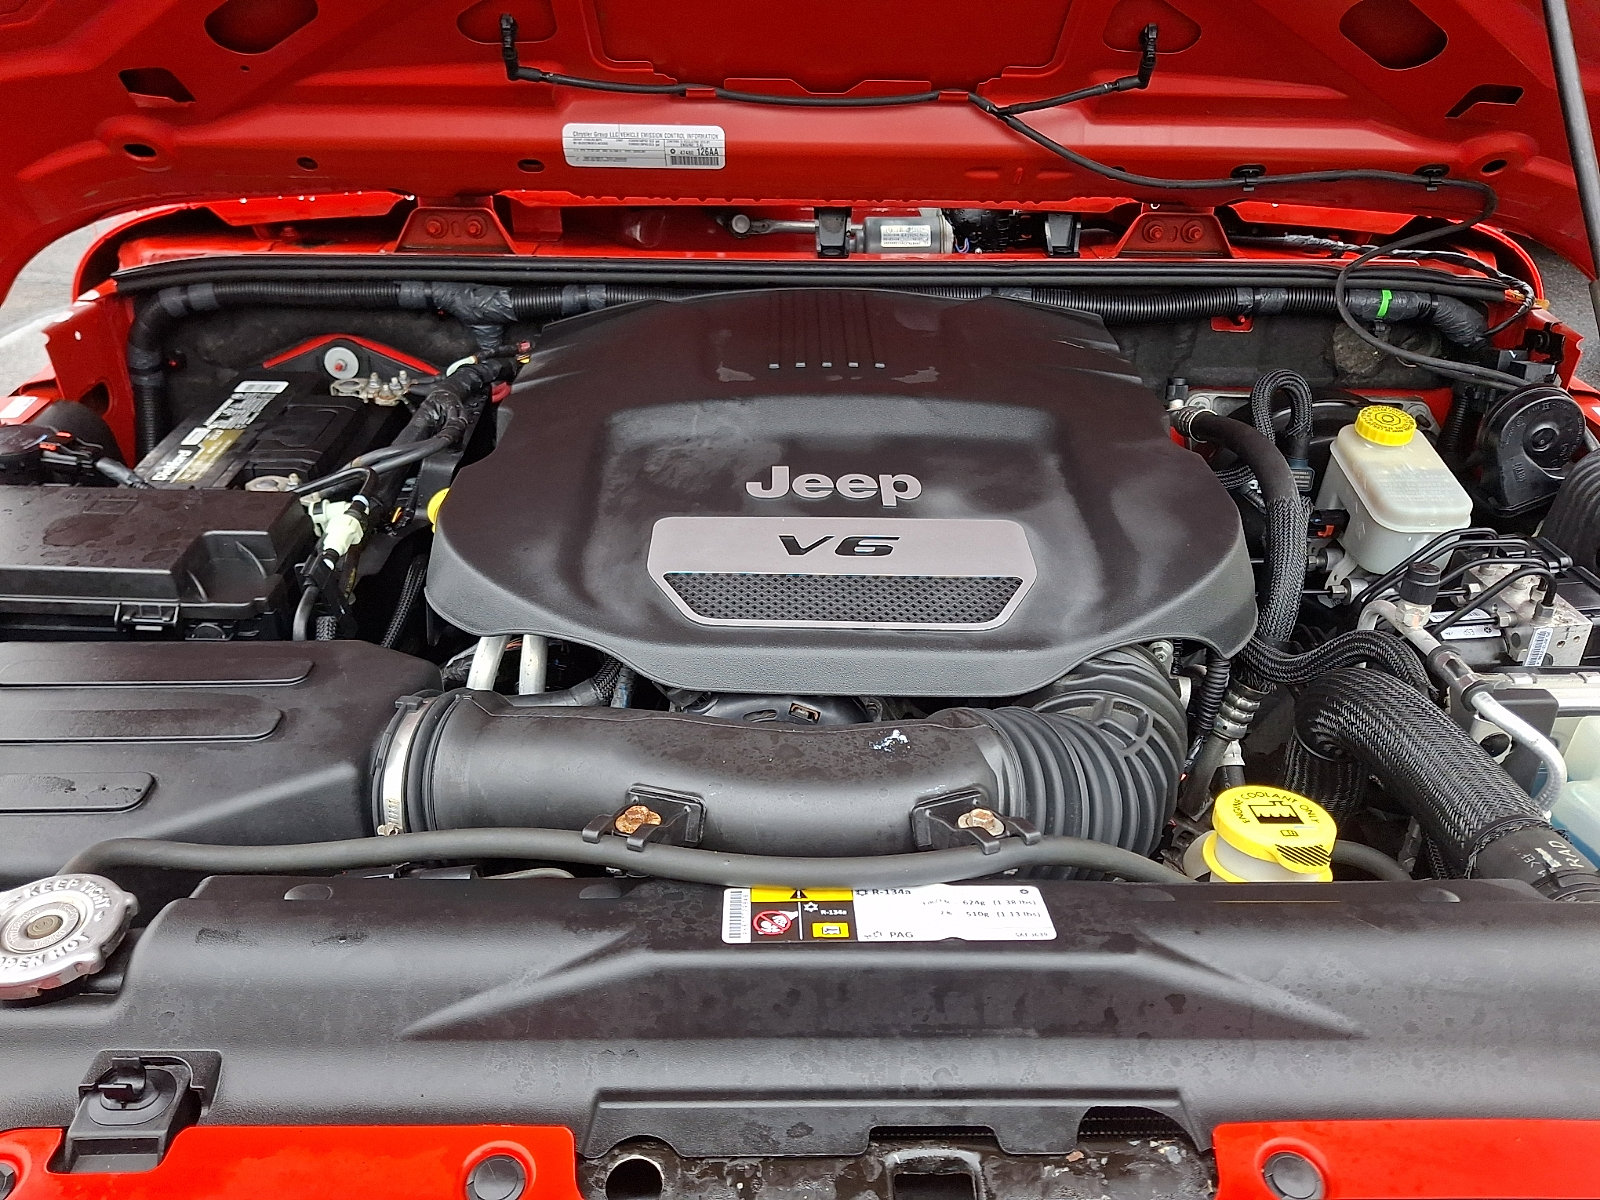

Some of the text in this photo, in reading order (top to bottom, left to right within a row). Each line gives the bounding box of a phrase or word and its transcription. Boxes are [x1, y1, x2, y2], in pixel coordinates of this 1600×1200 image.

[572, 130, 593, 138] Chrysler
[696, 148, 719, 156] 126AA
[745, 464, 923, 507] Jeep
[777, 534, 901, 557] V6
[1240, 791, 1298, 804] COOLANT
[1232, 797, 1251, 824] ENGINE
[1548, 840, 1584, 868] RAD
[22, 877, 112, 909] KEEP TIGHT
[872, 887, 912, 896] R-134a
[48, 931, 91, 961] HOT
[889, 931, 914, 939] PAG
